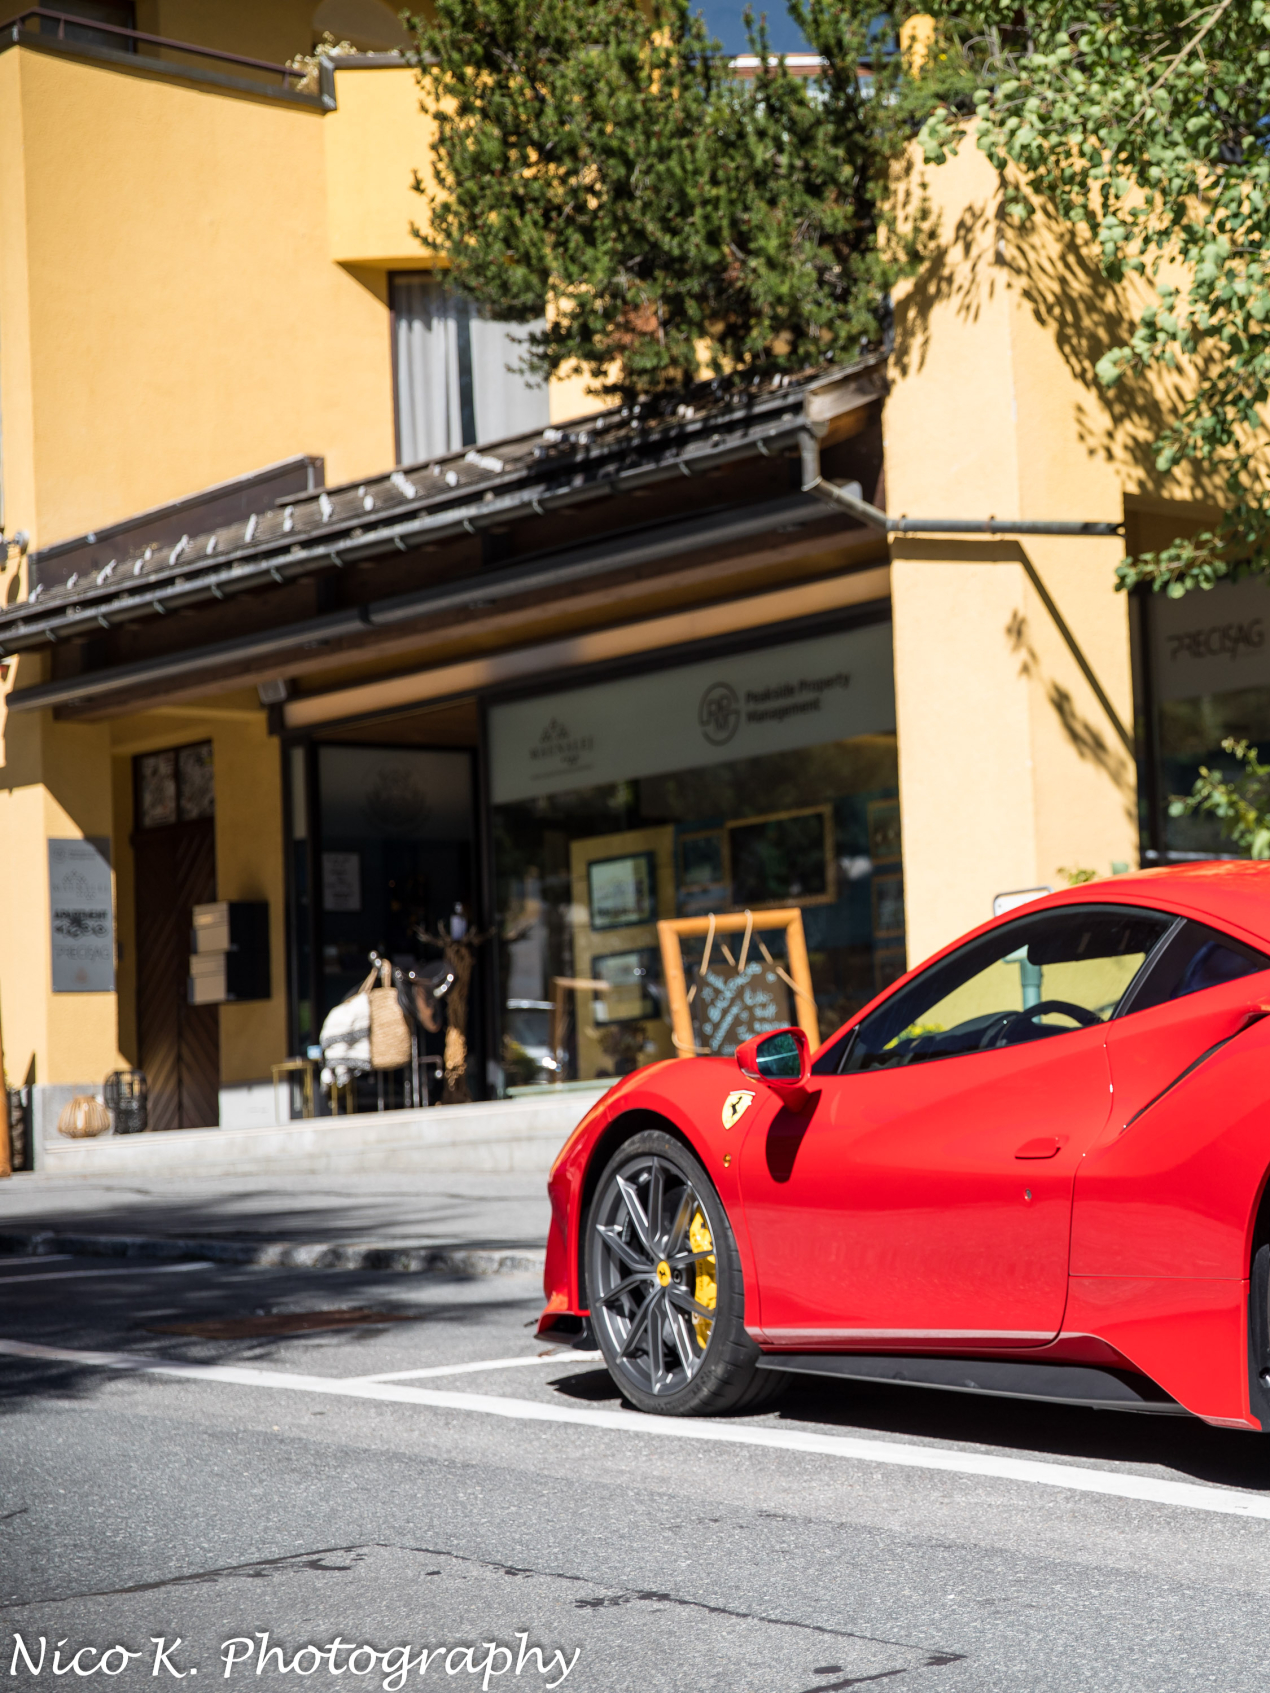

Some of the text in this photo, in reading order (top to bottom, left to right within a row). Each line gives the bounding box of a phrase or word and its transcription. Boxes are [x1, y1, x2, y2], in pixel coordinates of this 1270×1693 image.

[745, 673, 850, 704] Peakside Property
[746, 698, 821, 722] Management
